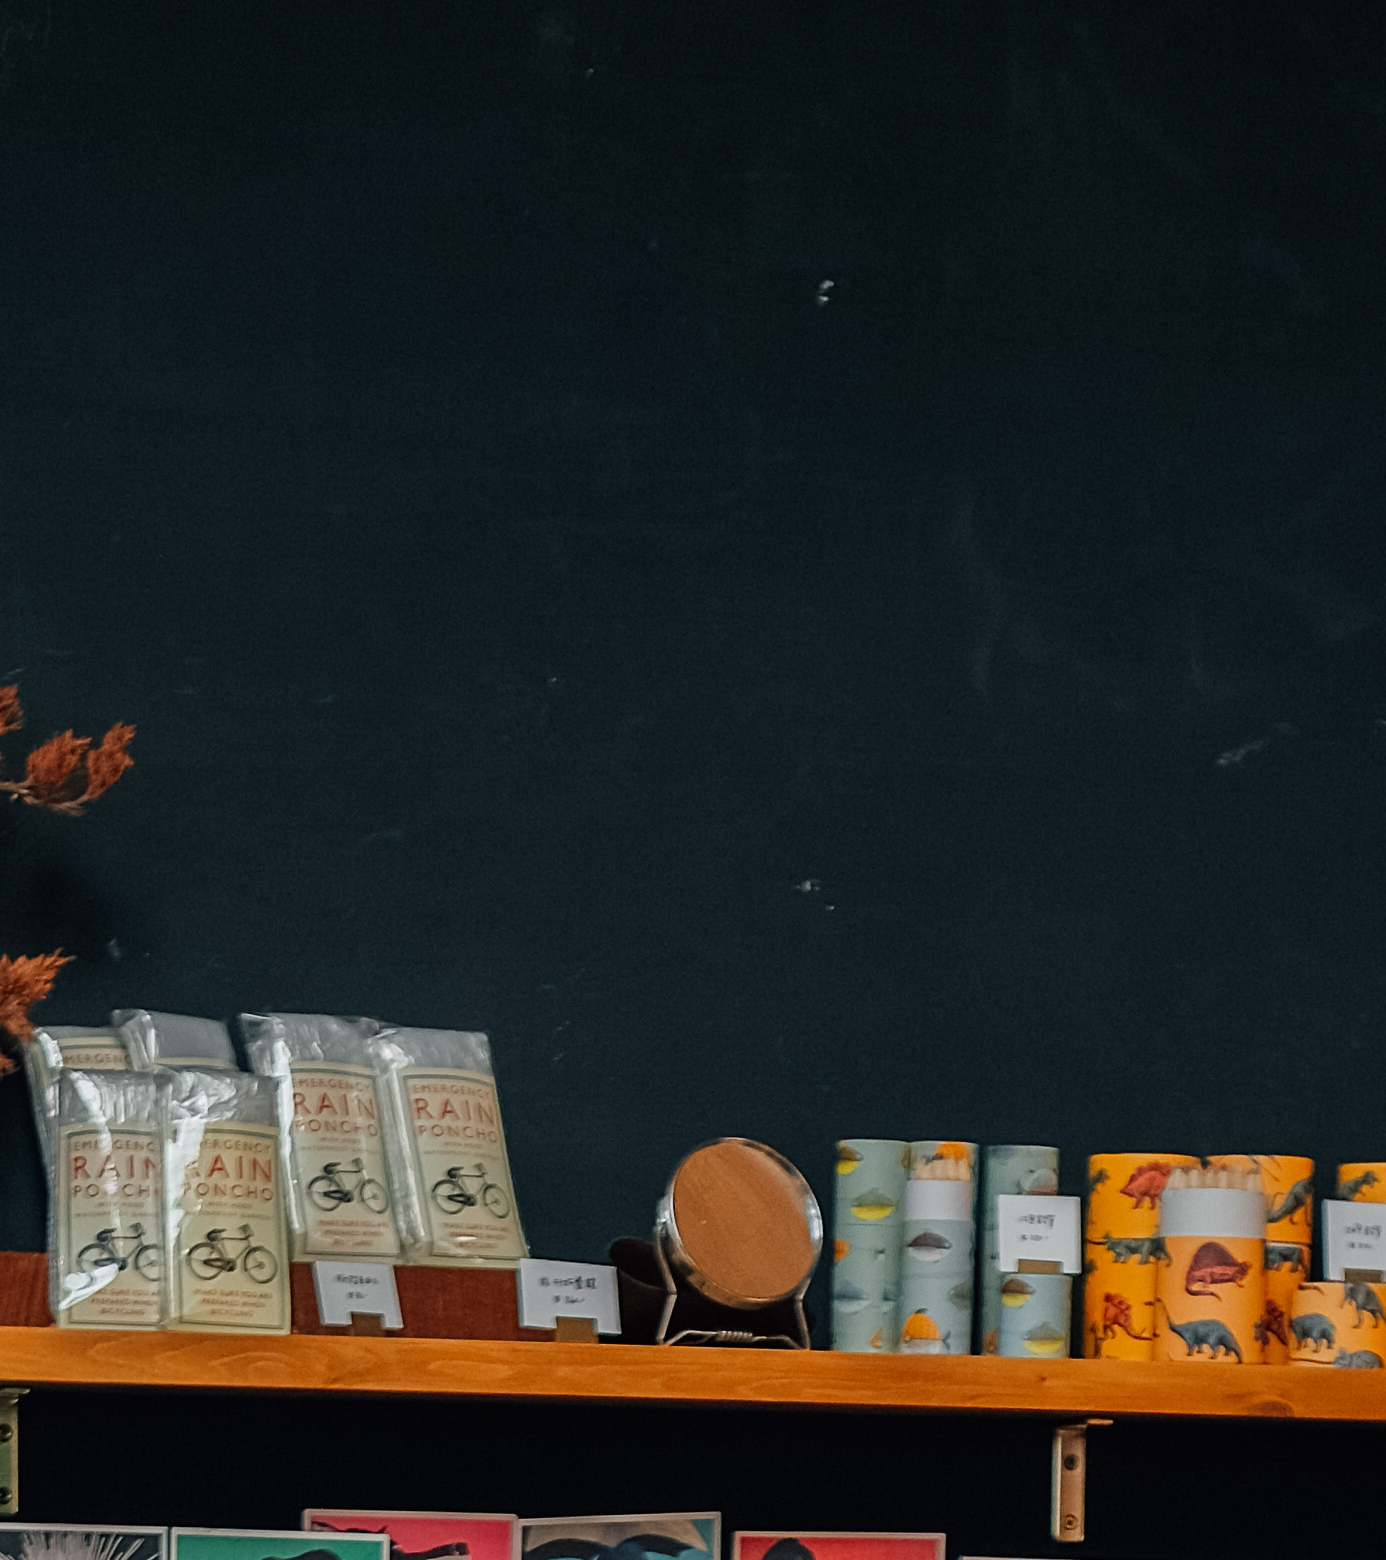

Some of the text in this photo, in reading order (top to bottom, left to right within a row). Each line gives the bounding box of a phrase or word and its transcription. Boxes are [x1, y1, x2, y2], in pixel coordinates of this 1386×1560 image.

[412, 1083, 492, 1099] EMERGENCY
[293, 1092, 377, 1120] RAIN
[413, 1098, 497, 1127] RAIN
[294, 1118, 379, 1138] PONCHO
[418, 1123, 500, 1144] PONCHO
